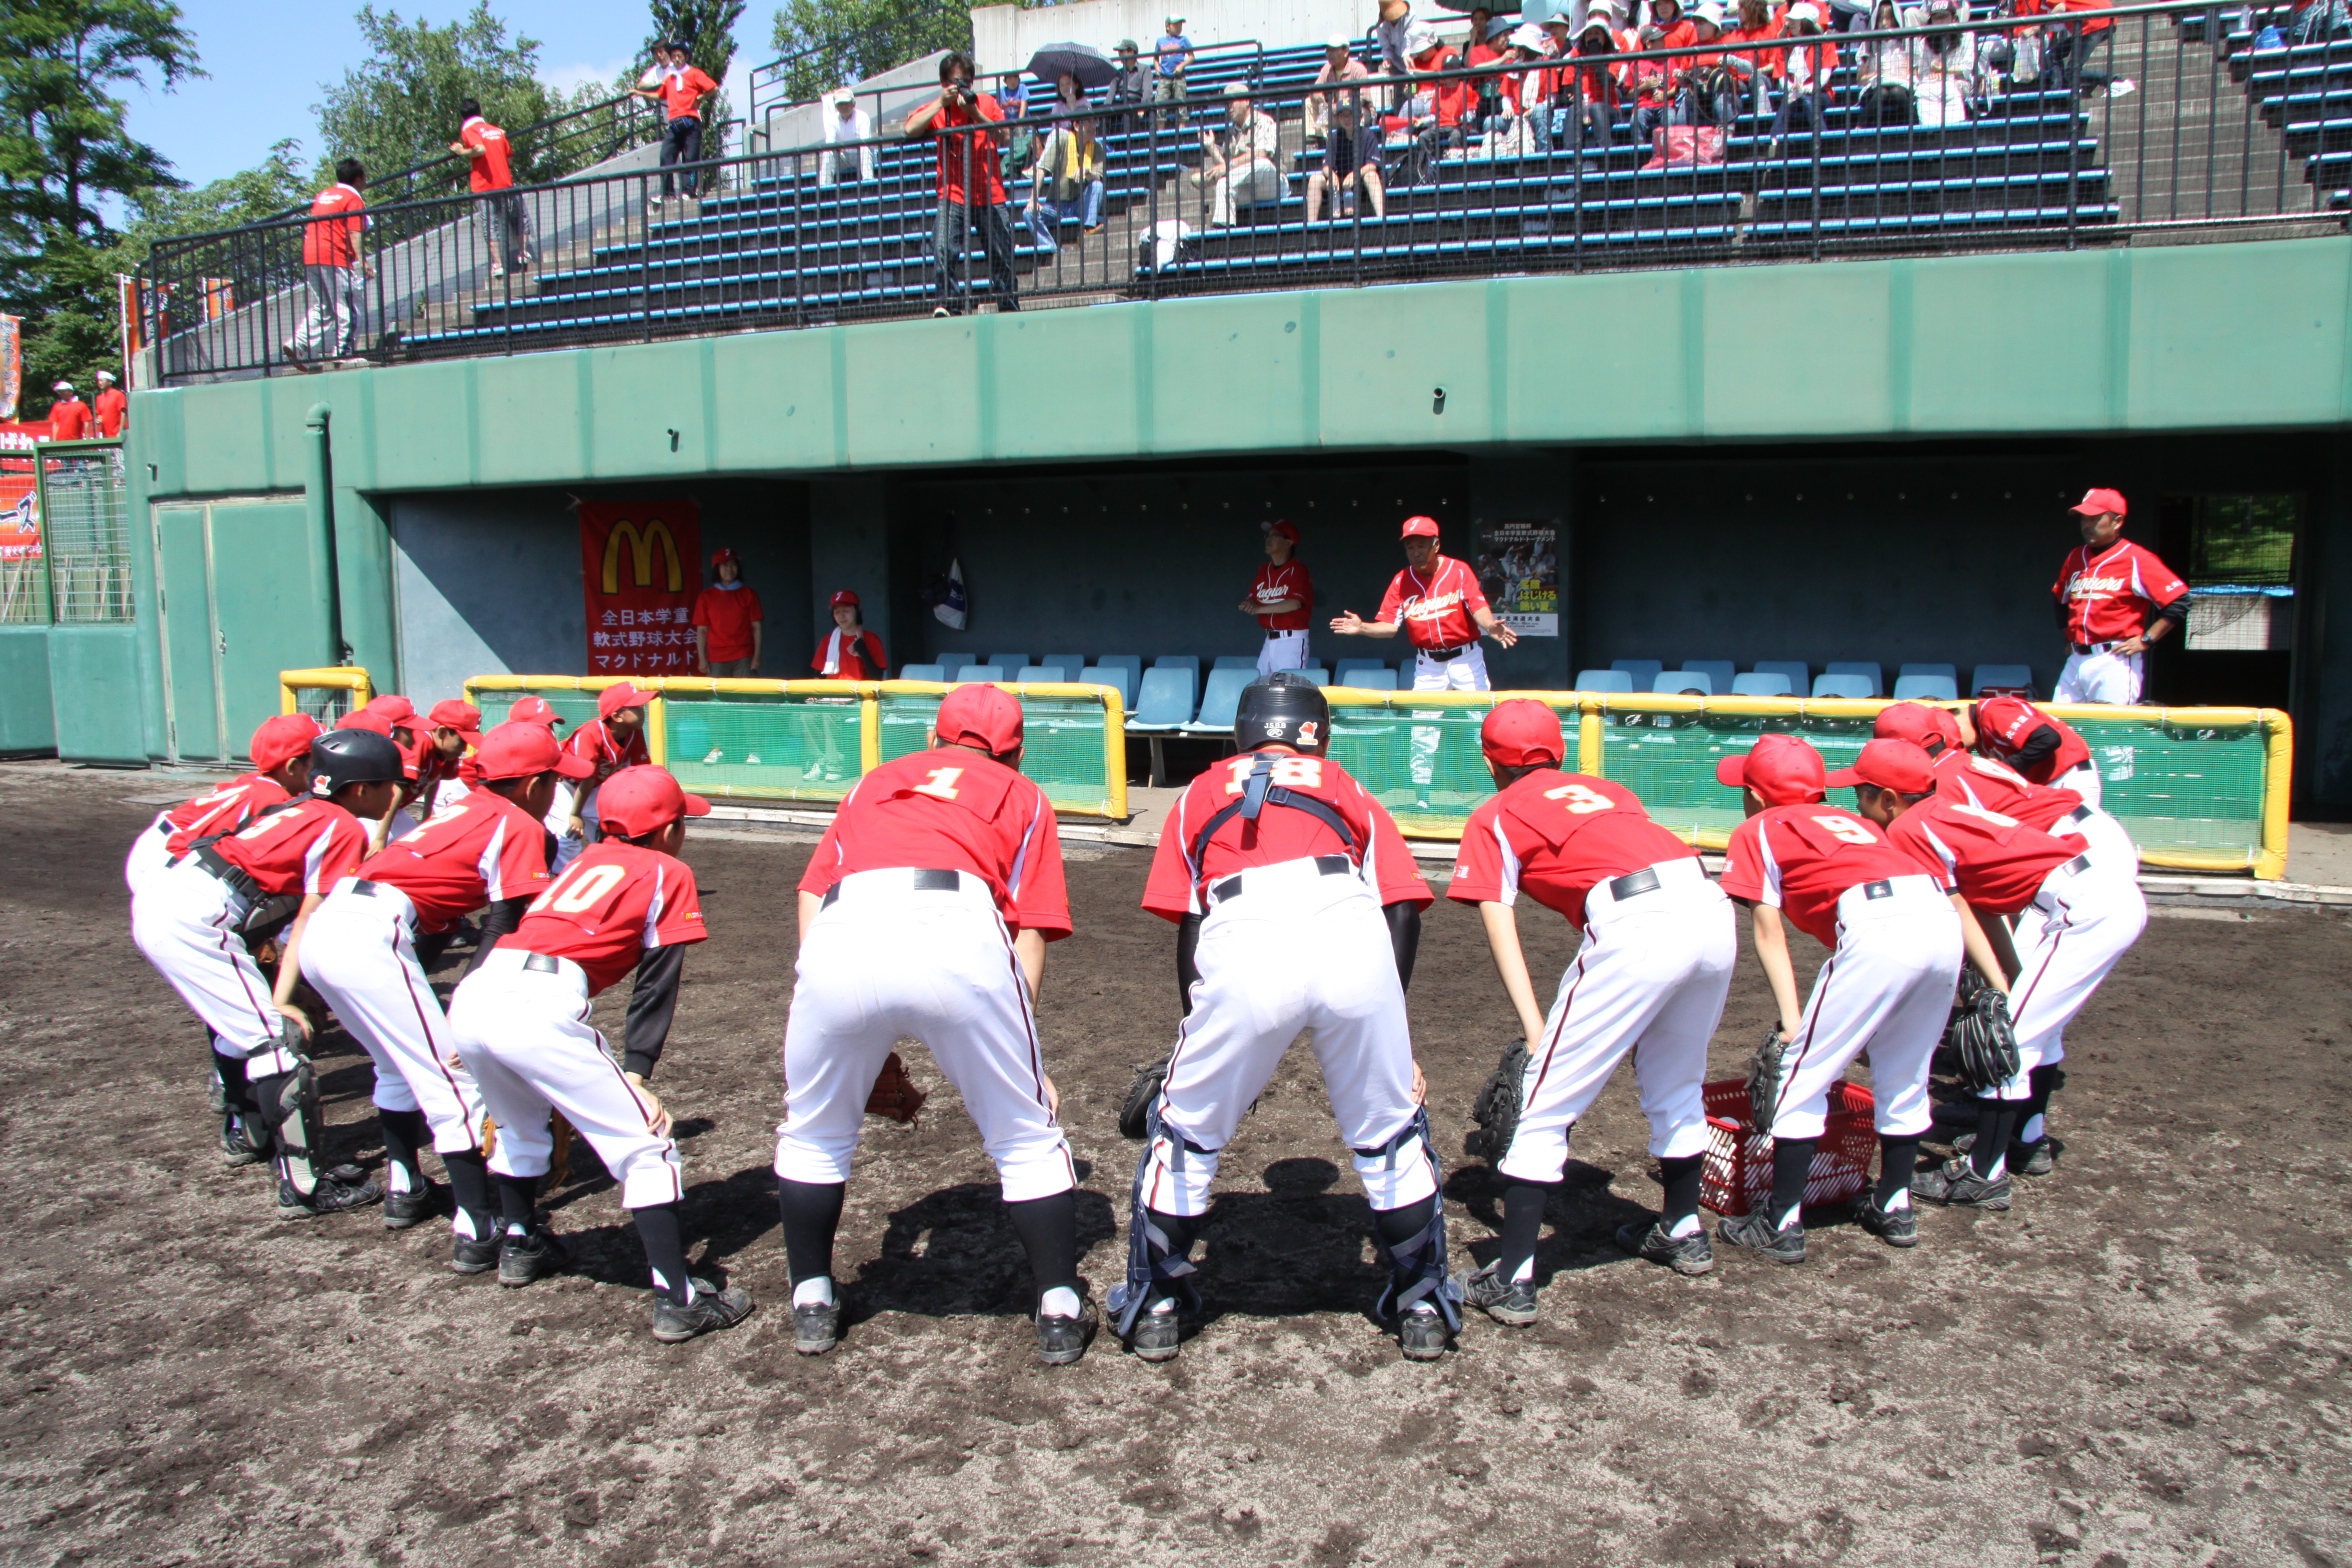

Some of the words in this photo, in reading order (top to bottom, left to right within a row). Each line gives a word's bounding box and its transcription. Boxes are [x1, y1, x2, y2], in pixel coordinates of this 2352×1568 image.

[601, 607, 690, 626] 全日本学童
[1403, 588, 1460, 619] Jaguars
[593, 628, 698, 648] 軟式野球大会
[595, 651, 698, 668] マクドナルド
[912, 767, 964, 799] 1
[1543, 784, 1615, 814] 3
[1810, 815, 1878, 844] 9
[526, 860, 626, 913] 10
